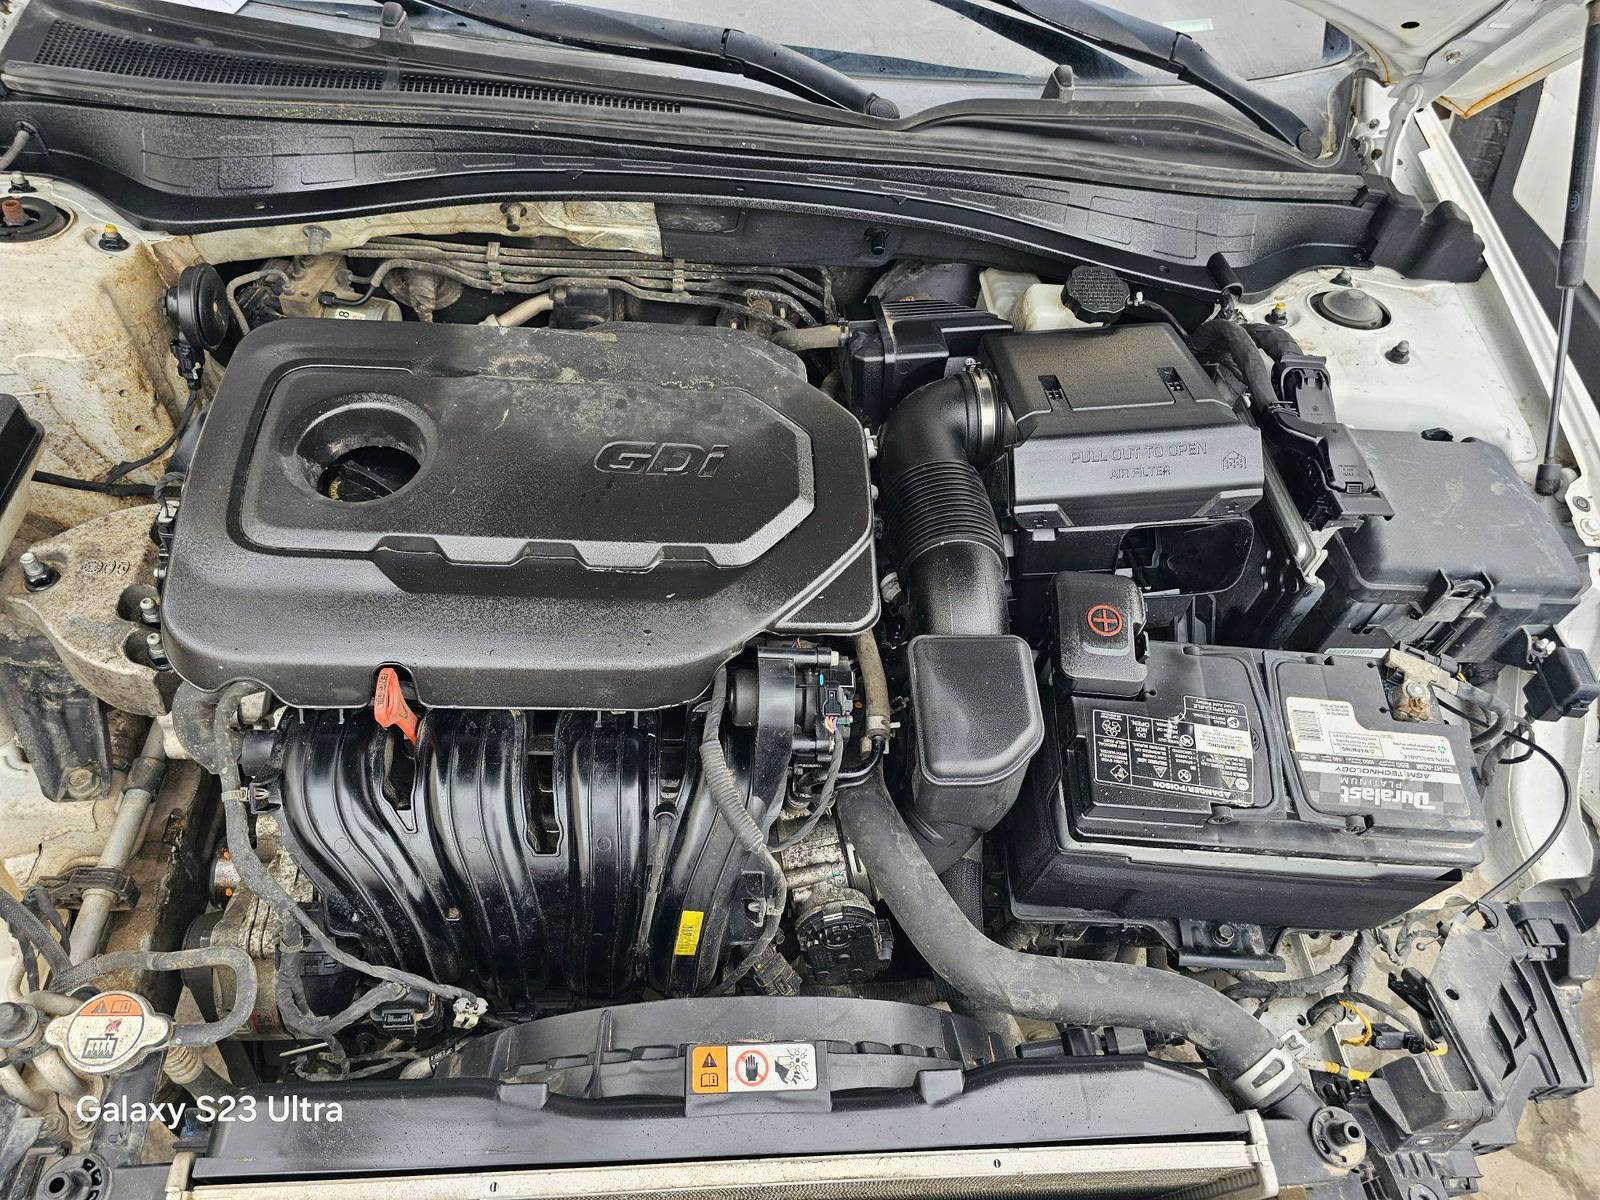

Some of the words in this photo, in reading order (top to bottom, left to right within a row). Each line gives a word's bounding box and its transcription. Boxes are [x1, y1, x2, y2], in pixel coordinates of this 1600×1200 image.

[1070, 449, 1108, 464] PULL
[1112, 446, 1141, 461] OUT
[1143, 444, 1164, 459] TO
[1167, 440, 1207, 457] OPEN
[1109, 468, 1130, 480] AIR
[1132, 465, 1171, 478] FILTER
[1335, 766, 1404, 777] TECHNOLOGY
[1153, 780, 1224, 797] DANGER/POISON
[1340, 777, 1402, 788] PLATINUM
[1340, 786, 1436, 810] Duralast
